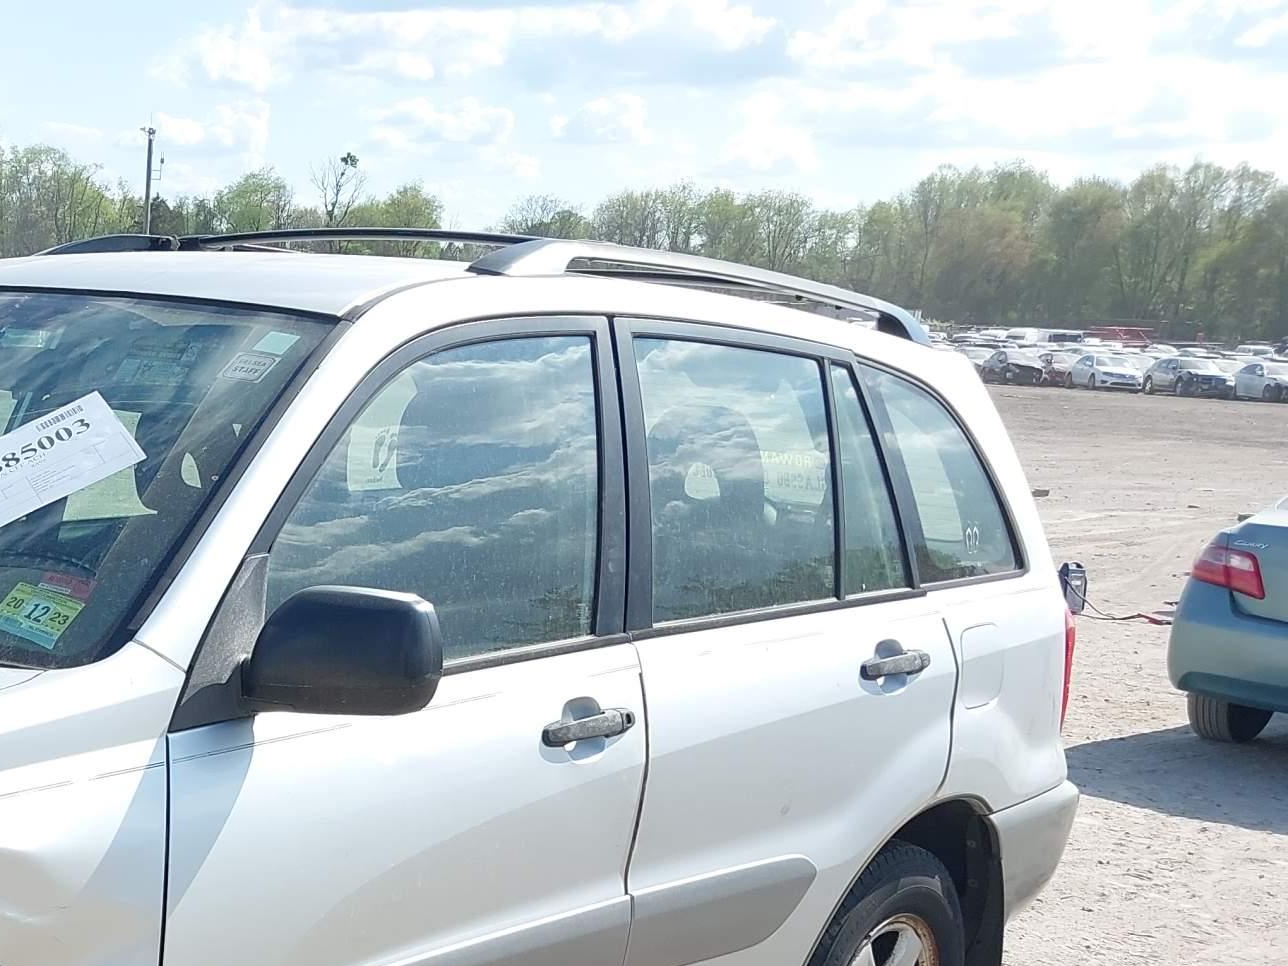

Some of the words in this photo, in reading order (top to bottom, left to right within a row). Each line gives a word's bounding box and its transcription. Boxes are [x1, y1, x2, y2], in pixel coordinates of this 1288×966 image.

[232, 365, 261, 375] STAFF
[6, 596, 25, 609] 20
[23, 602, 51, 624] 12
[48, 611, 70, 625] 23
